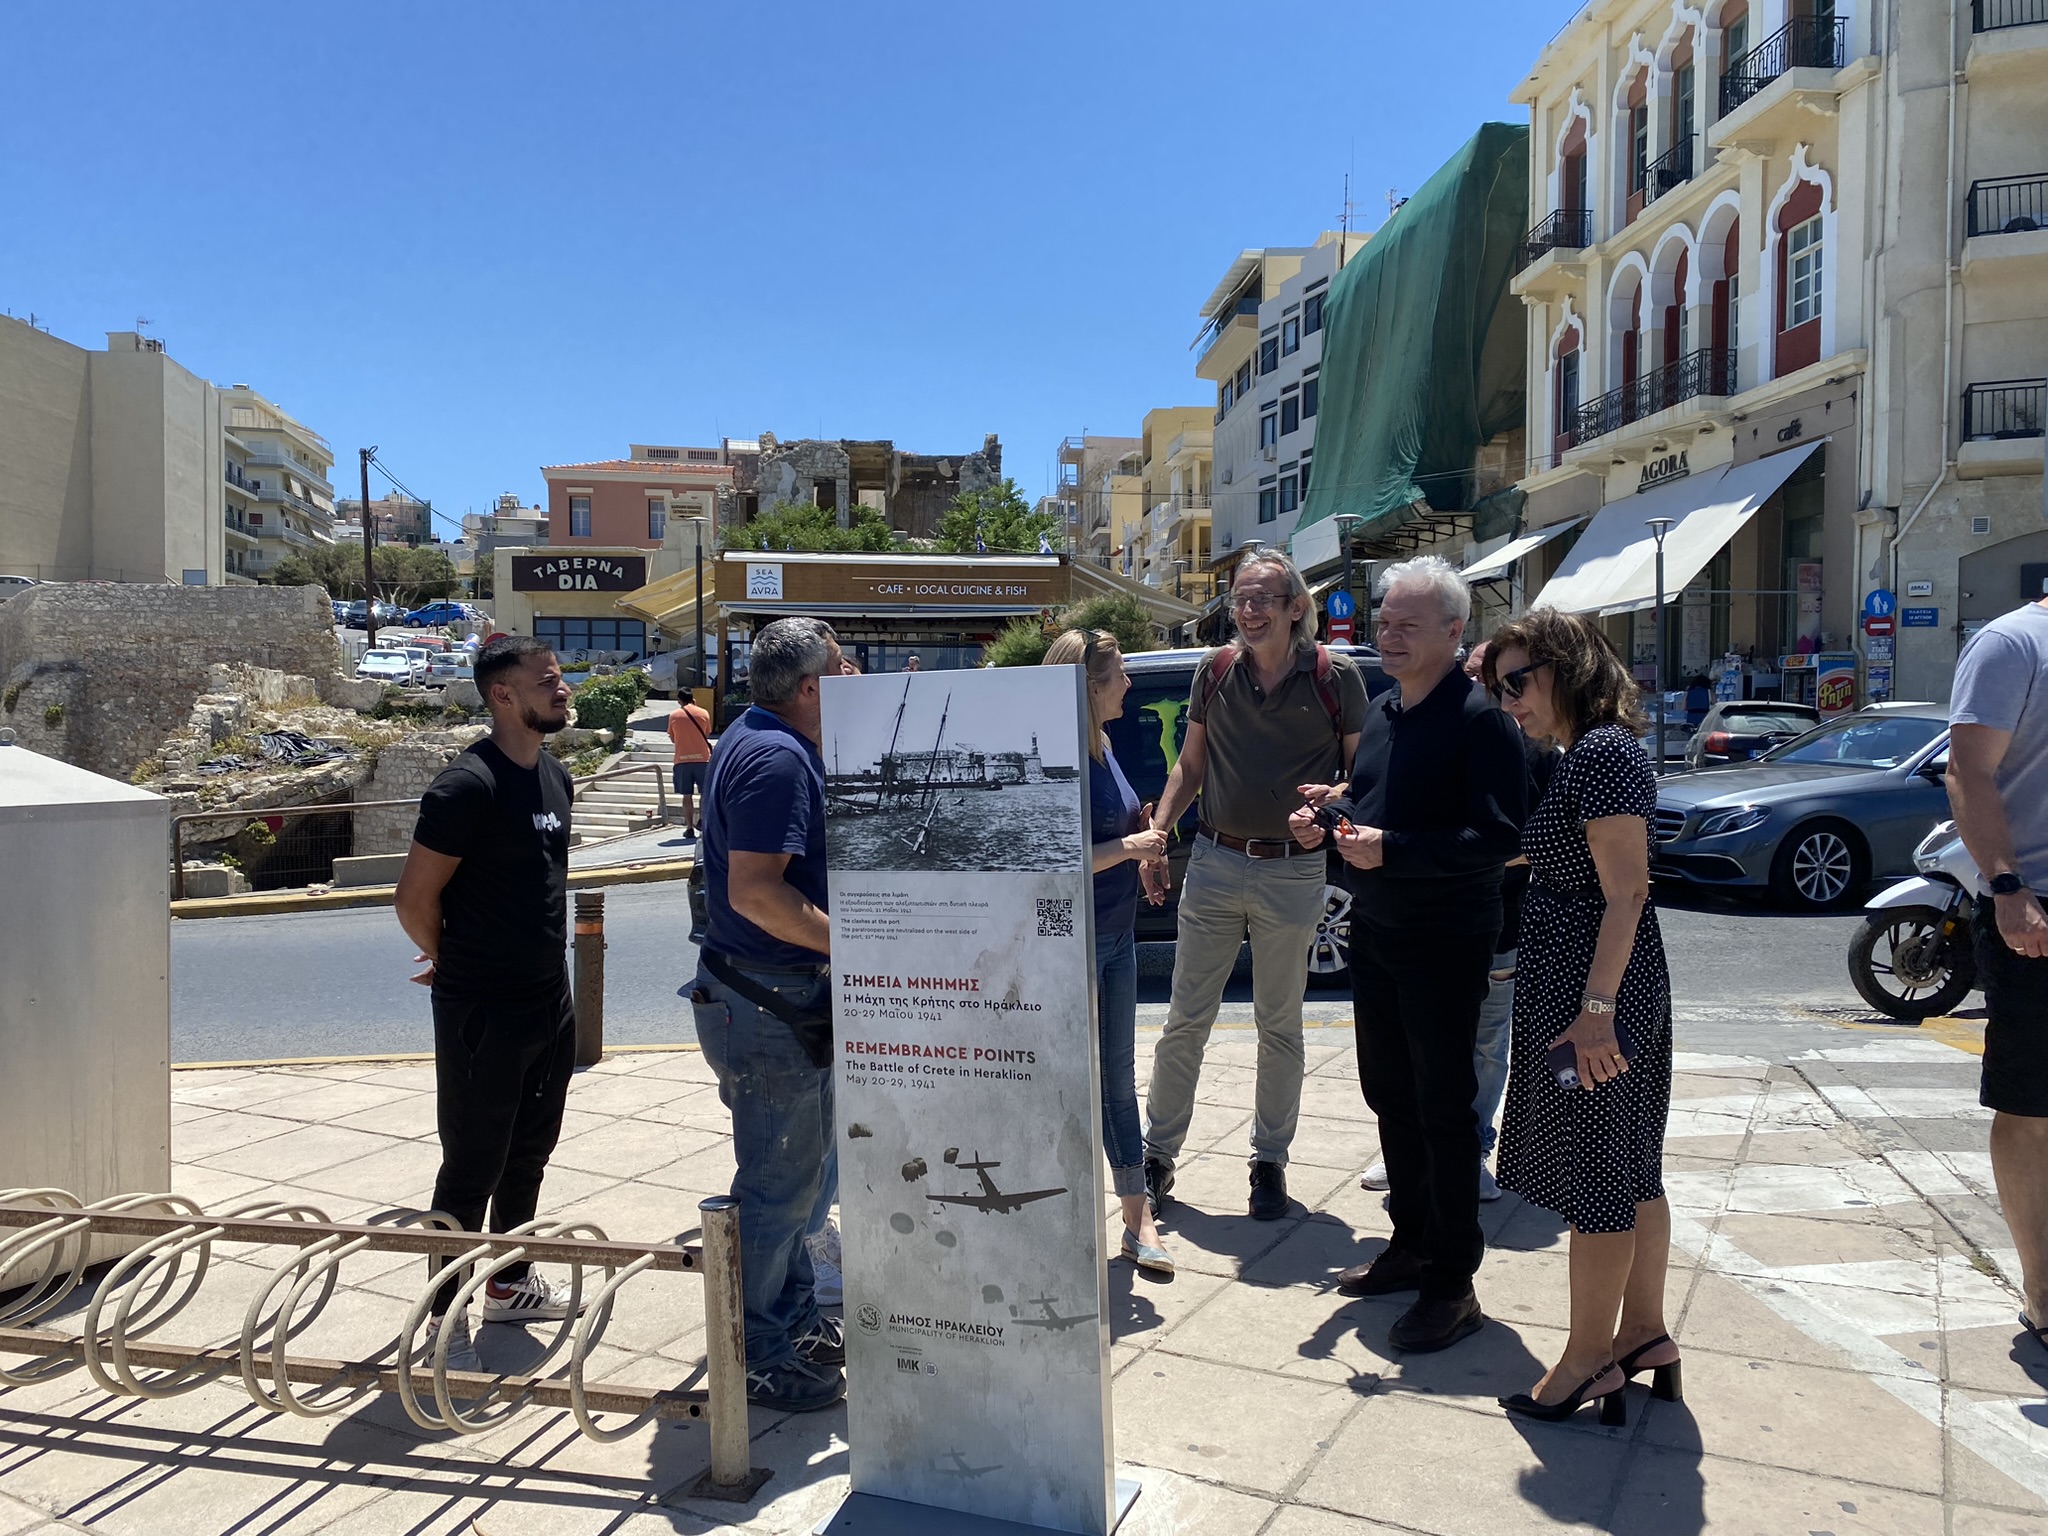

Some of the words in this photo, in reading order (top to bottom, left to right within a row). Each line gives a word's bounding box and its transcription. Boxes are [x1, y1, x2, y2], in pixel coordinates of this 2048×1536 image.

[1778, 418, 1802, 442] café
[533, 558, 624, 579] ΤΑΒΕΡΝΑ
[558, 574, 598, 590] DIA
[750, 587, 778, 596] AVRA
[878, 584, 904, 594] CAFE
[915, 584, 949, 595] LOCAL
[951, 585, 992, 596] CUICINE
[994, 586, 1003, 596] &
[1006, 586, 1027, 596] FISH
[843, 974, 902, 989] ΣΗΜΕΙΑ
[908, 977, 980, 992] ΜΝΗΜΗΣ
[844, 994, 851, 1003] Η
[855, 994, 885, 1007] Μάχη
[889, 998, 908, 1008] της
[912, 997, 955, 1010] Κρήτης
[959, 1000, 980, 1009] στο
[984, 1000, 1042, 1014] Ηράκλειο
[844, 1009, 875, 1018] 20-29
[879, 1009, 914, 1020] Μαΐου
[918, 1012, 942, 1021] 1941
[846, 1041, 967, 1060] REMEMBRANCE
[974, 1048, 1036, 1064] POINTS
[846, 1061, 866, 1071] The
[870, 1062, 904, 1073] Battle
[908, 1063, 919, 1074] of
[923, 1065, 955, 1076] Crete
[960, 1066, 969, 1077] in
[975, 1068, 1031, 1081] Heraklion
[846, 1074, 867, 1087] May
[872, 1077, 907, 1088] 20-29,
[911, 1079, 935, 1089] 1941
[889, 1313, 931, 1328] ΔΗΜΟΣ
[936, 1319, 1004, 1338] ΗΡΑΚΛΕΙΟΥ
[889, 1325, 944, 1339] MUNICIPALITY
[959, 1334, 1005, 1347] HERAKLION
[898, 1358, 919, 1371] IMK
